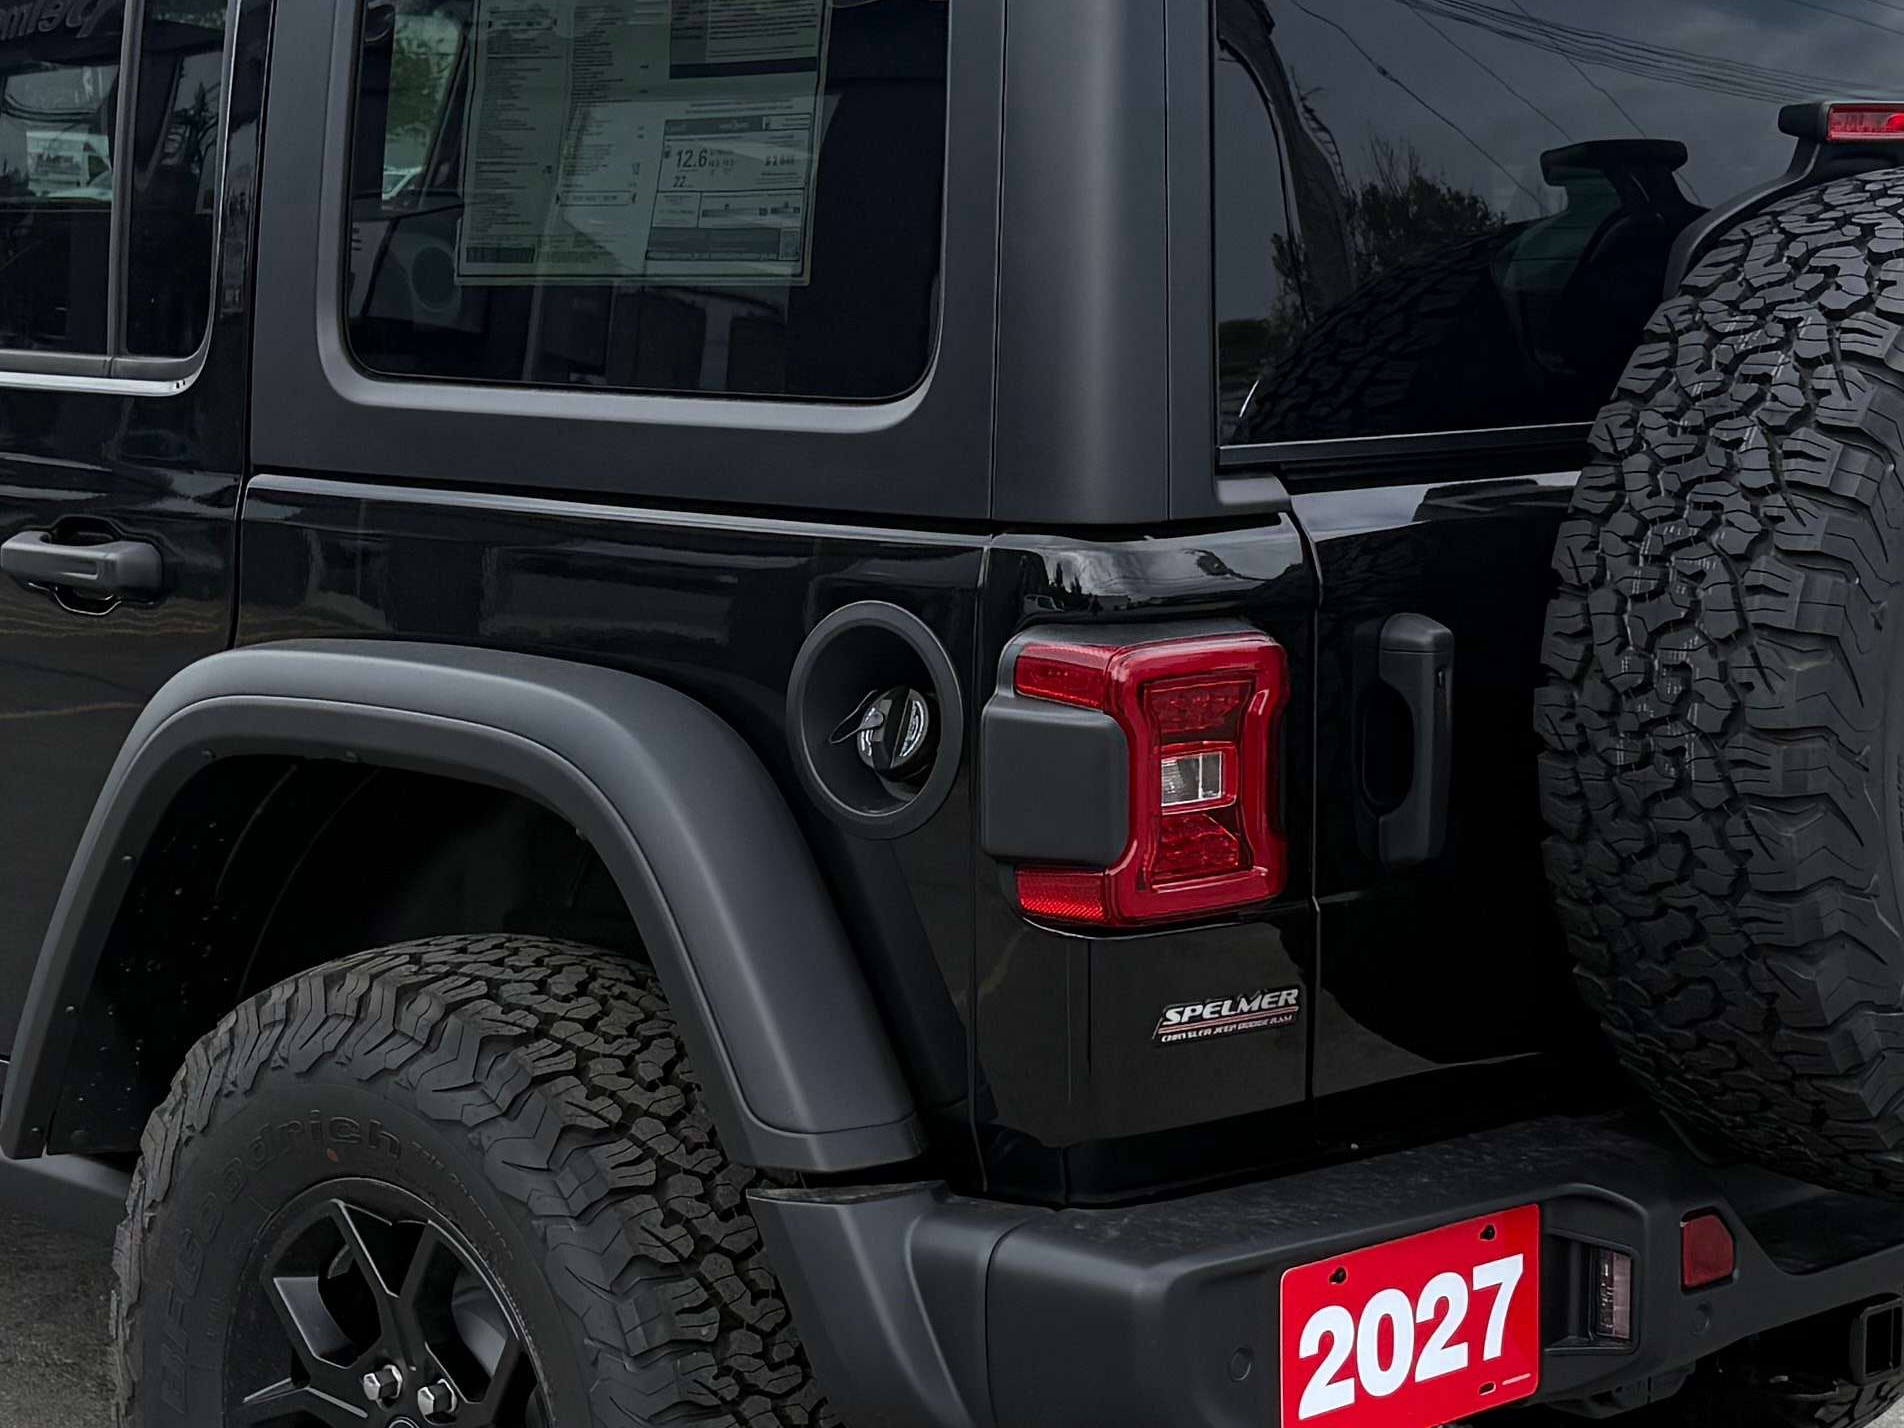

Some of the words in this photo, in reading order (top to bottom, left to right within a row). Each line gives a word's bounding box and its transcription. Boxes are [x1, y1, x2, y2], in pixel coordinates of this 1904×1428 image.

[676, 148, 708, 169] 12.6
[1162, 988, 1300, 1026] SPELMER
[1298, 1253, 1524, 1421] 2027
